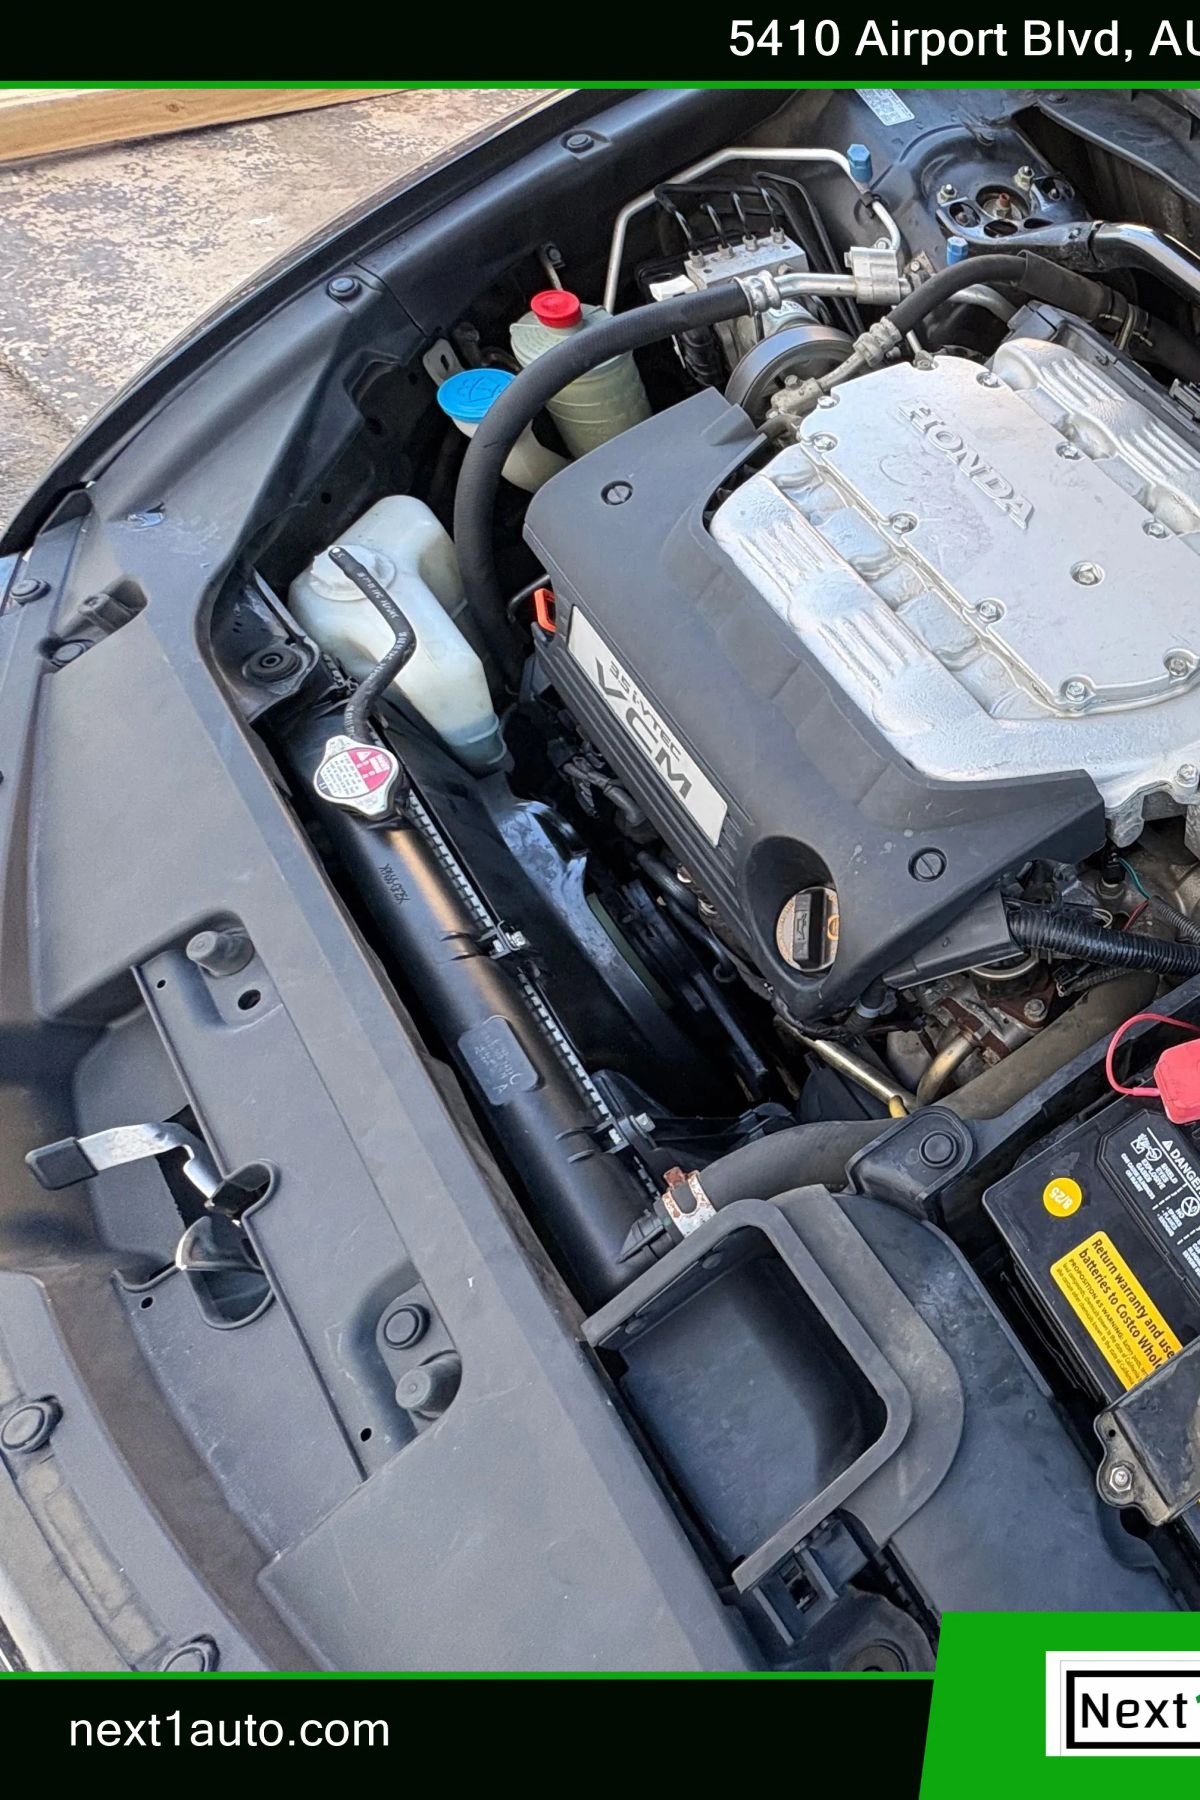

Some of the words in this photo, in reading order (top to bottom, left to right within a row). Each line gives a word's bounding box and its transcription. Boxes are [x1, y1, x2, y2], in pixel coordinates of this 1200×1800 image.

[897, 398, 1036, 532] HONDA
[596, 657, 692, 800] VCM
[1174, 1207, 1185, 1219] NO
[1067, 1258, 1099, 1300] PROPOSITION
[1094, 1297, 1104, 1309] 65
[1077, 1247, 1114, 1294] batteries
[1106, 1291, 1121, 1306] to
[1114, 1302, 1144, 1339] Costco
[1090, 1237, 1120, 1275] Return
[1111, 1272, 1149, 1320] warranty
[1143, 1316, 1164, 1339] and
[1157, 1338, 1175, 1360] use
